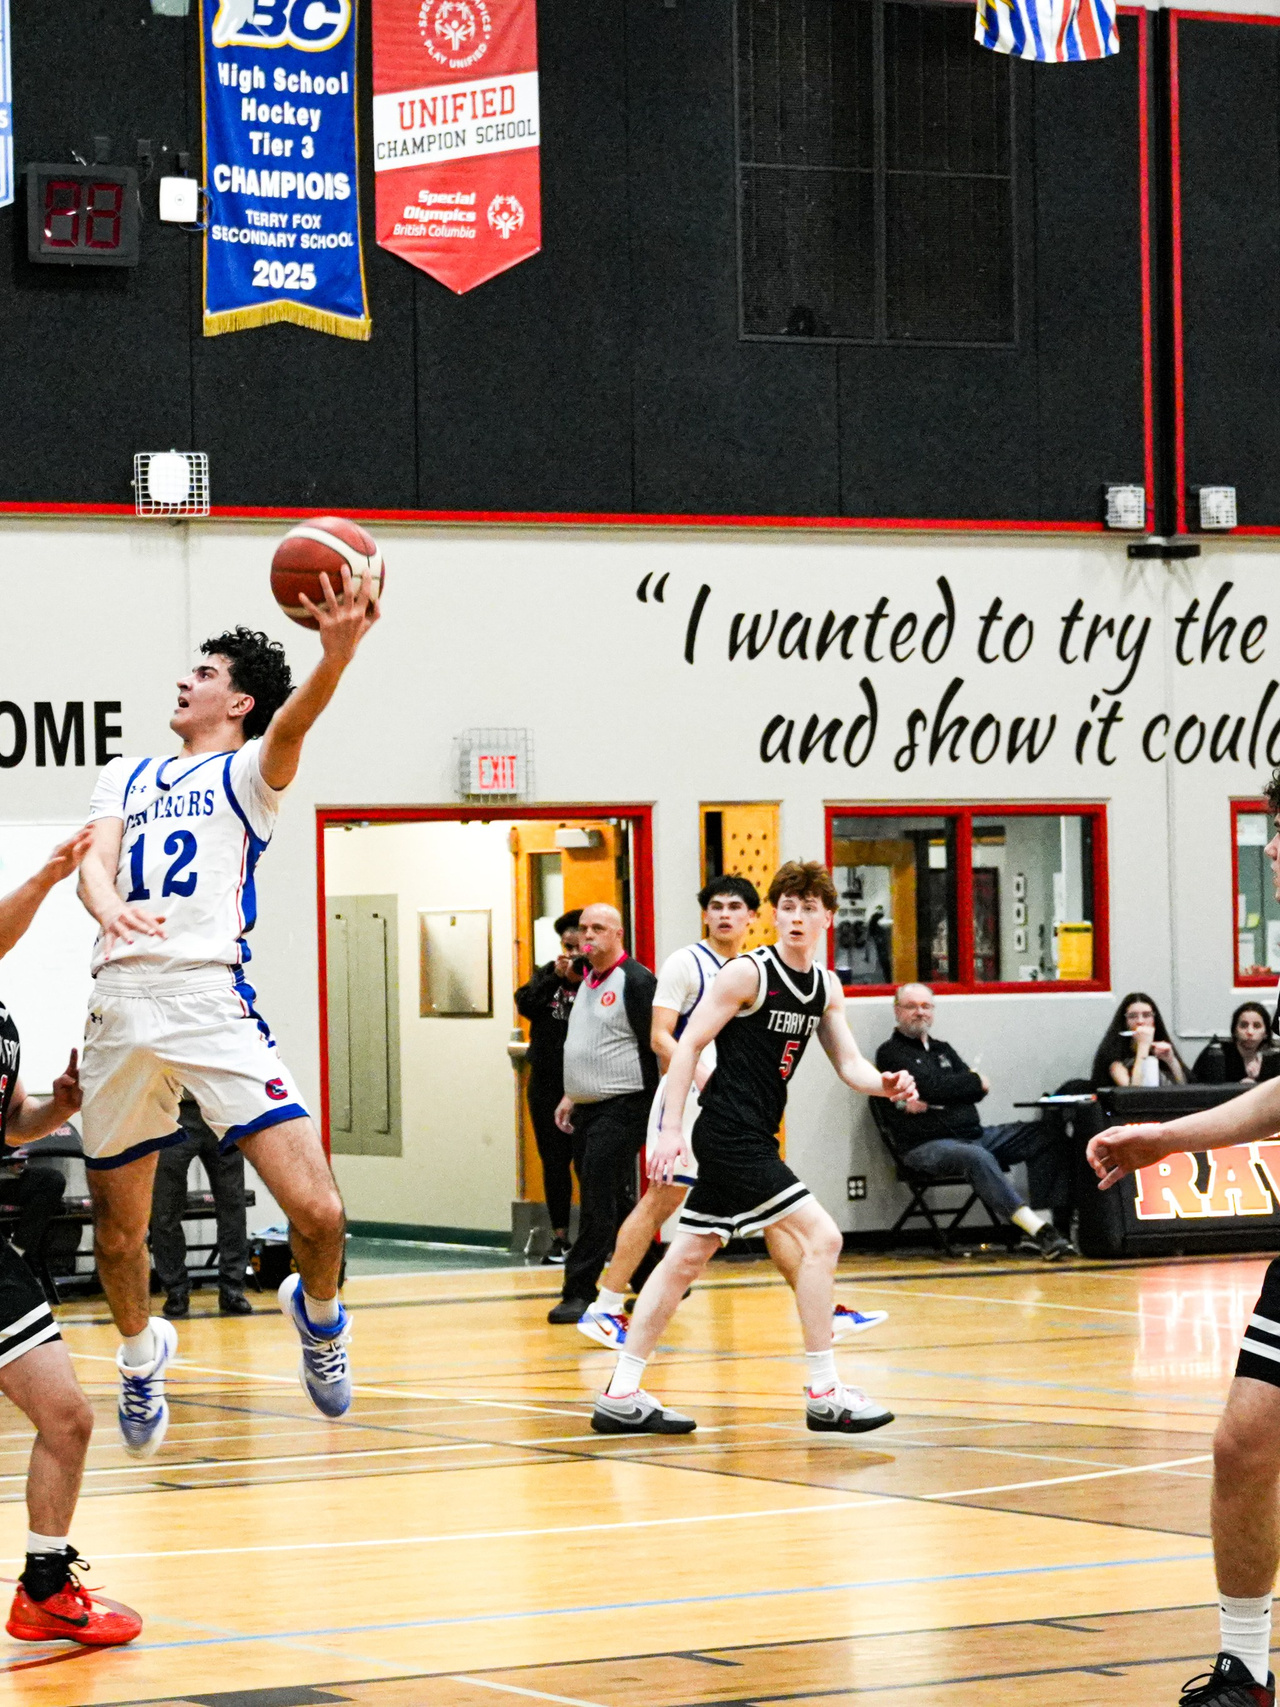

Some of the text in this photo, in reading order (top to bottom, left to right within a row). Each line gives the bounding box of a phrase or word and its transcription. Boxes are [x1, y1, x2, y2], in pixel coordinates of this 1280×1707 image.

[218, 62, 349, 95] High School
[241, 97, 321, 132] Hockey
[398, 85, 515, 131] UNIFIED
[249, 131, 315, 159] Tier 3
[376, 119, 536, 160] CHAMPION SCHOOL
[403, 205, 476, 223] Olympics
[418, 190, 476, 206] Special
[245, 209, 321, 229] TERRY FOX
[393, 223, 476, 239] British Columbia
[212, 225, 354, 249] SECONDARY SCHOOL
[252, 259, 317, 290] 2025
[728, 575, 955, 664] wanted
[977, 596, 1034, 664] to
[1059, 598, 1151, 696] try
[1174, 581, 1268, 666] the
[760, 677, 878, 768] and
[894, 677, 1057, 772] show
[1075, 694, 1124, 766] it
[478, 755, 517, 790] EXIT
[125, 829, 198, 903] 12
[767, 1009, 806, 1035] TERRY
[778, 1040, 801, 1081] 5
